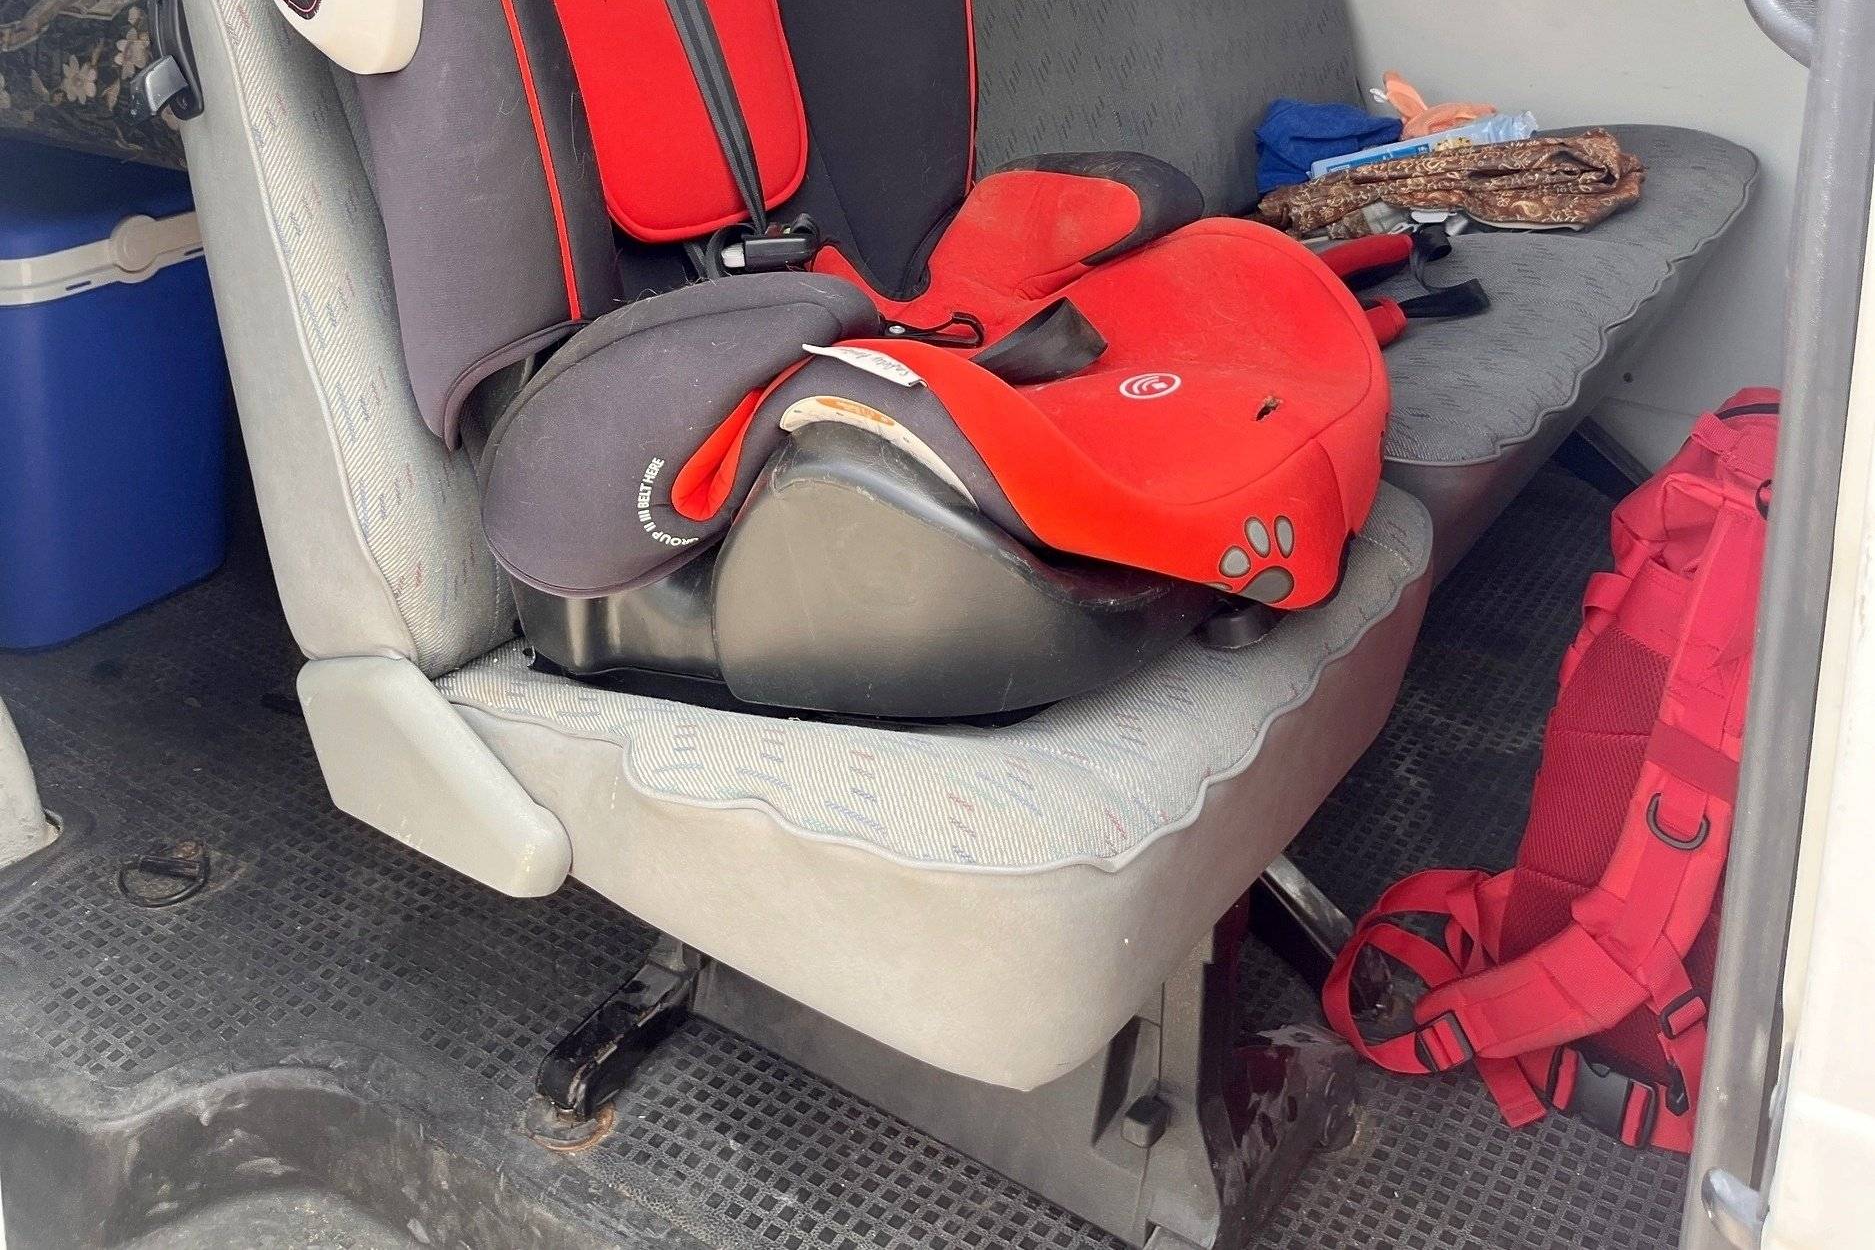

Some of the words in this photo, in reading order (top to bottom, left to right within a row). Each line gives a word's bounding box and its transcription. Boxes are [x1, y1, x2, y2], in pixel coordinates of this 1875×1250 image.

[642, 457, 665, 483] HERE
[637, 483, 652, 508] BELT
[637, 510, 652, 522] III
[643, 521, 657, 532] II
